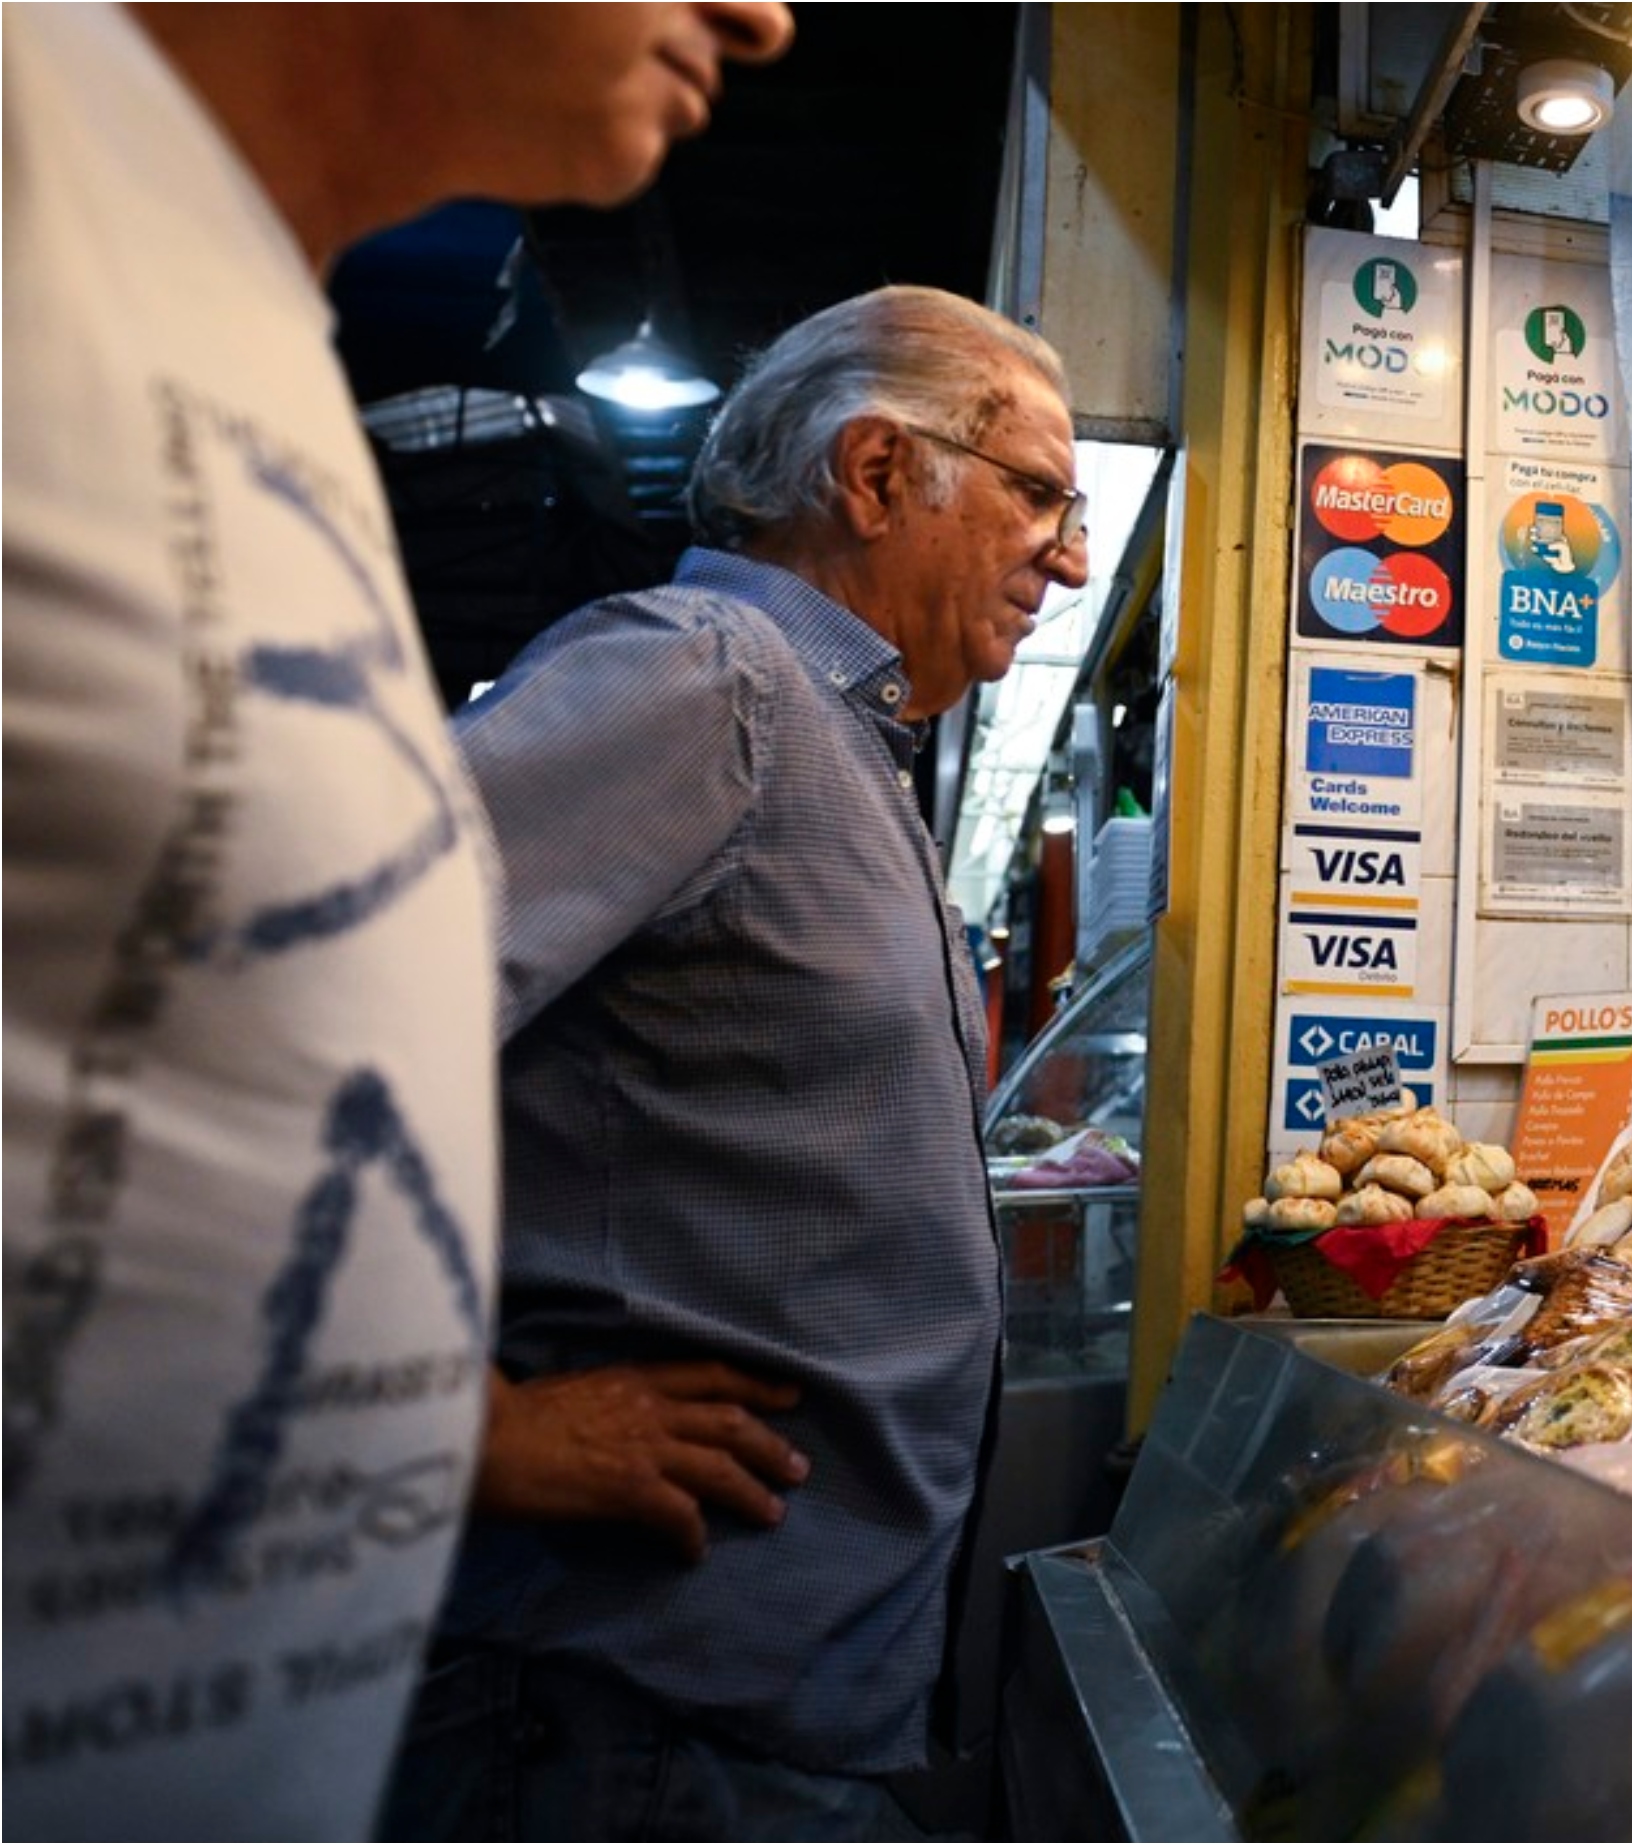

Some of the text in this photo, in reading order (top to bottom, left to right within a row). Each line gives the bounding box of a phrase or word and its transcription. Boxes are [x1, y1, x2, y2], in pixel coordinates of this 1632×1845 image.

[1389, 330, 1414, 342] con
[1324, 338, 1442, 378] MOD
[1561, 374, 1585, 386] con
[1503, 387, 1609, 419] MODO
[1316, 487, 1449, 519] MasterCard
[1324, 576, 1439, 608] Maestro
[1309, 704, 1407, 724] AMERICAN
[1332, 726, 1414, 745] EXPRESS
[1310, 777, 1368, 795] Cards
[1310, 797, 1400, 816] Welcome
[1307, 848, 1405, 886] VISA
[1303, 933, 1397, 970] VISA
